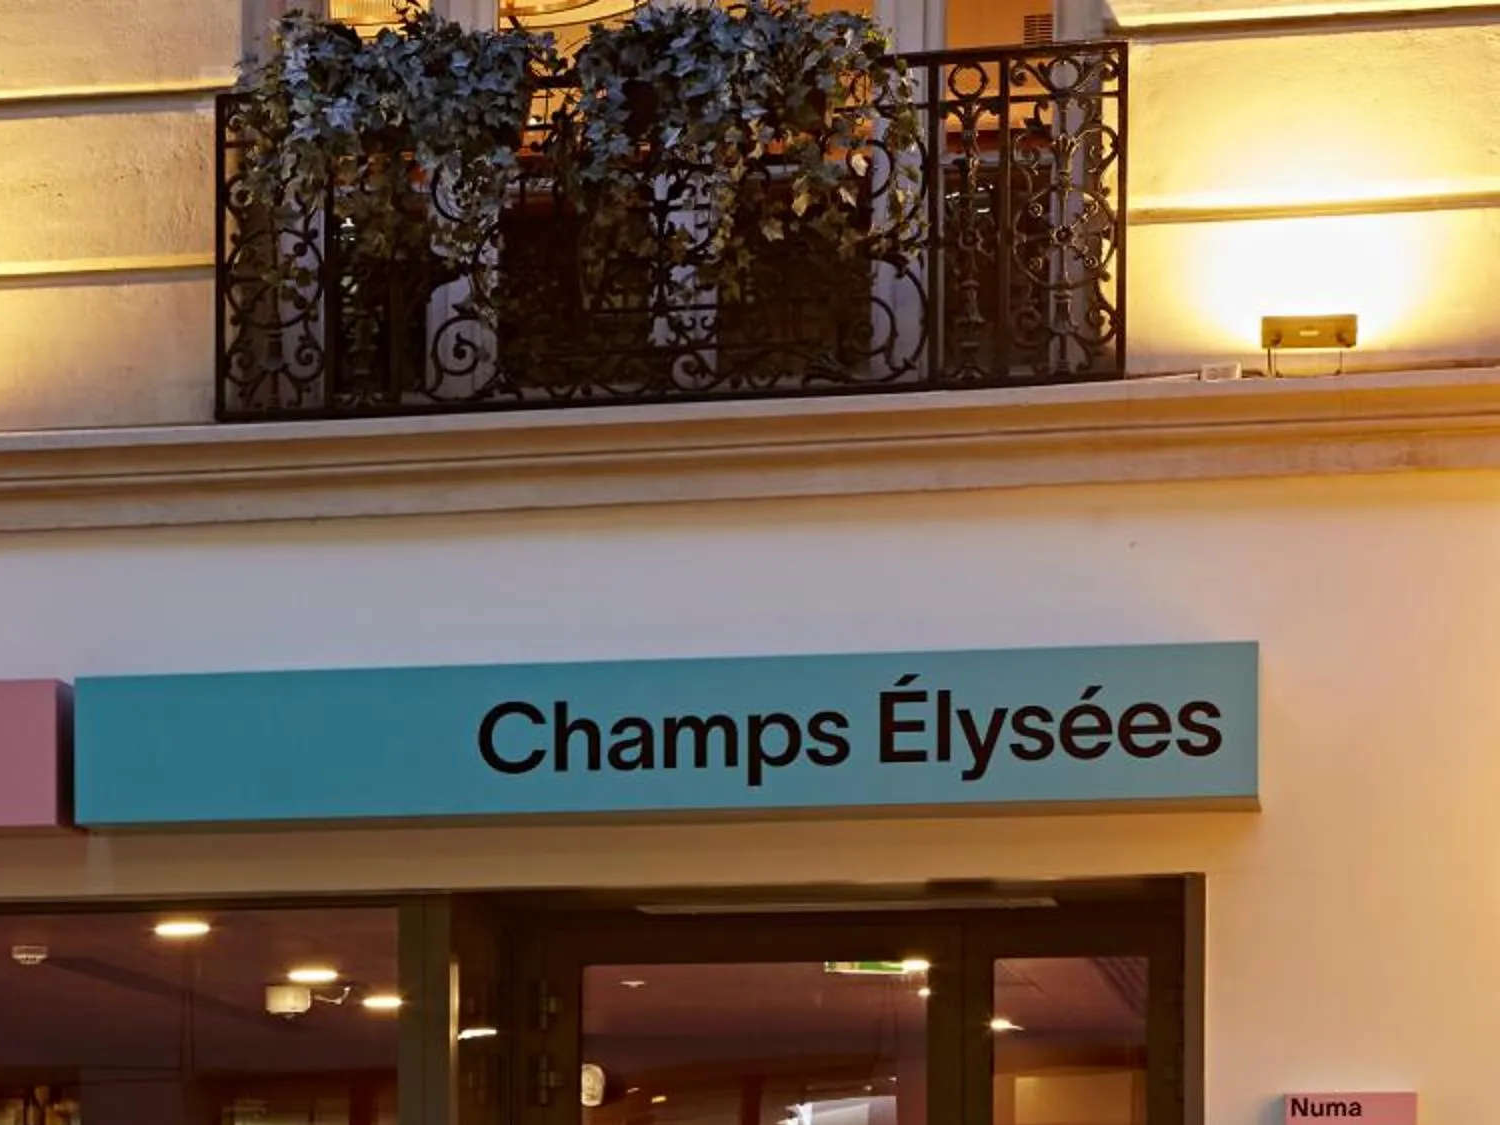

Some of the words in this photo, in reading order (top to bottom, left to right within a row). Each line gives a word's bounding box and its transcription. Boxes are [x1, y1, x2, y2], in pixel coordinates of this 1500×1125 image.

[477, 700, 851, 787] Champs
[879, 673, 1223, 782] Élysées
[1290, 1097, 1362, 1117] Numa
